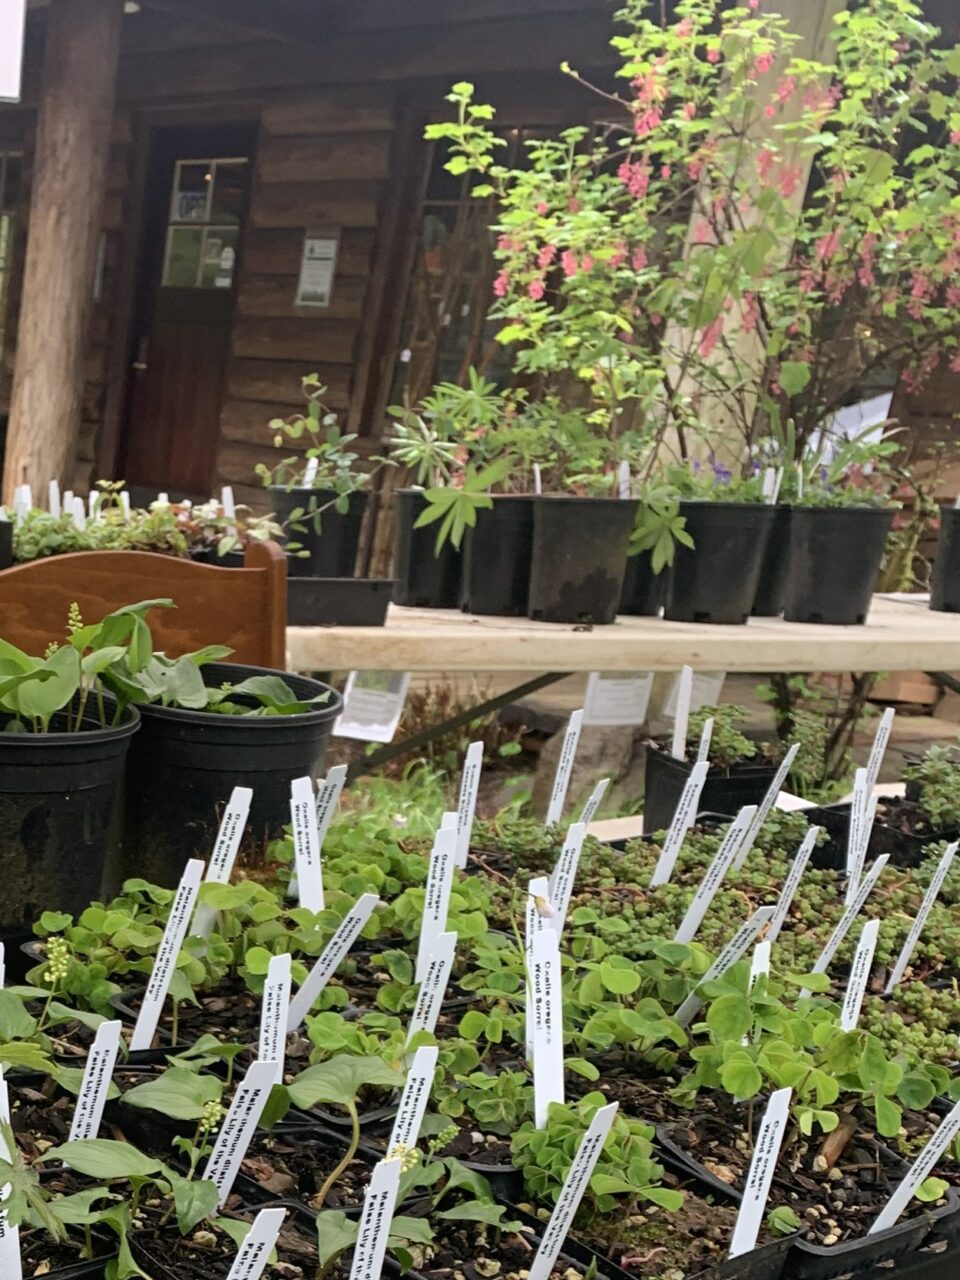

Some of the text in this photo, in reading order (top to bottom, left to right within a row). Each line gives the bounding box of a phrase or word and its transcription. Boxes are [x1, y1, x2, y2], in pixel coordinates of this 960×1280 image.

[212, 1117, 237, 1166] Lily of the
[364, 1193, 377, 1225] False
[359, 1226, 371, 1248] Lily
